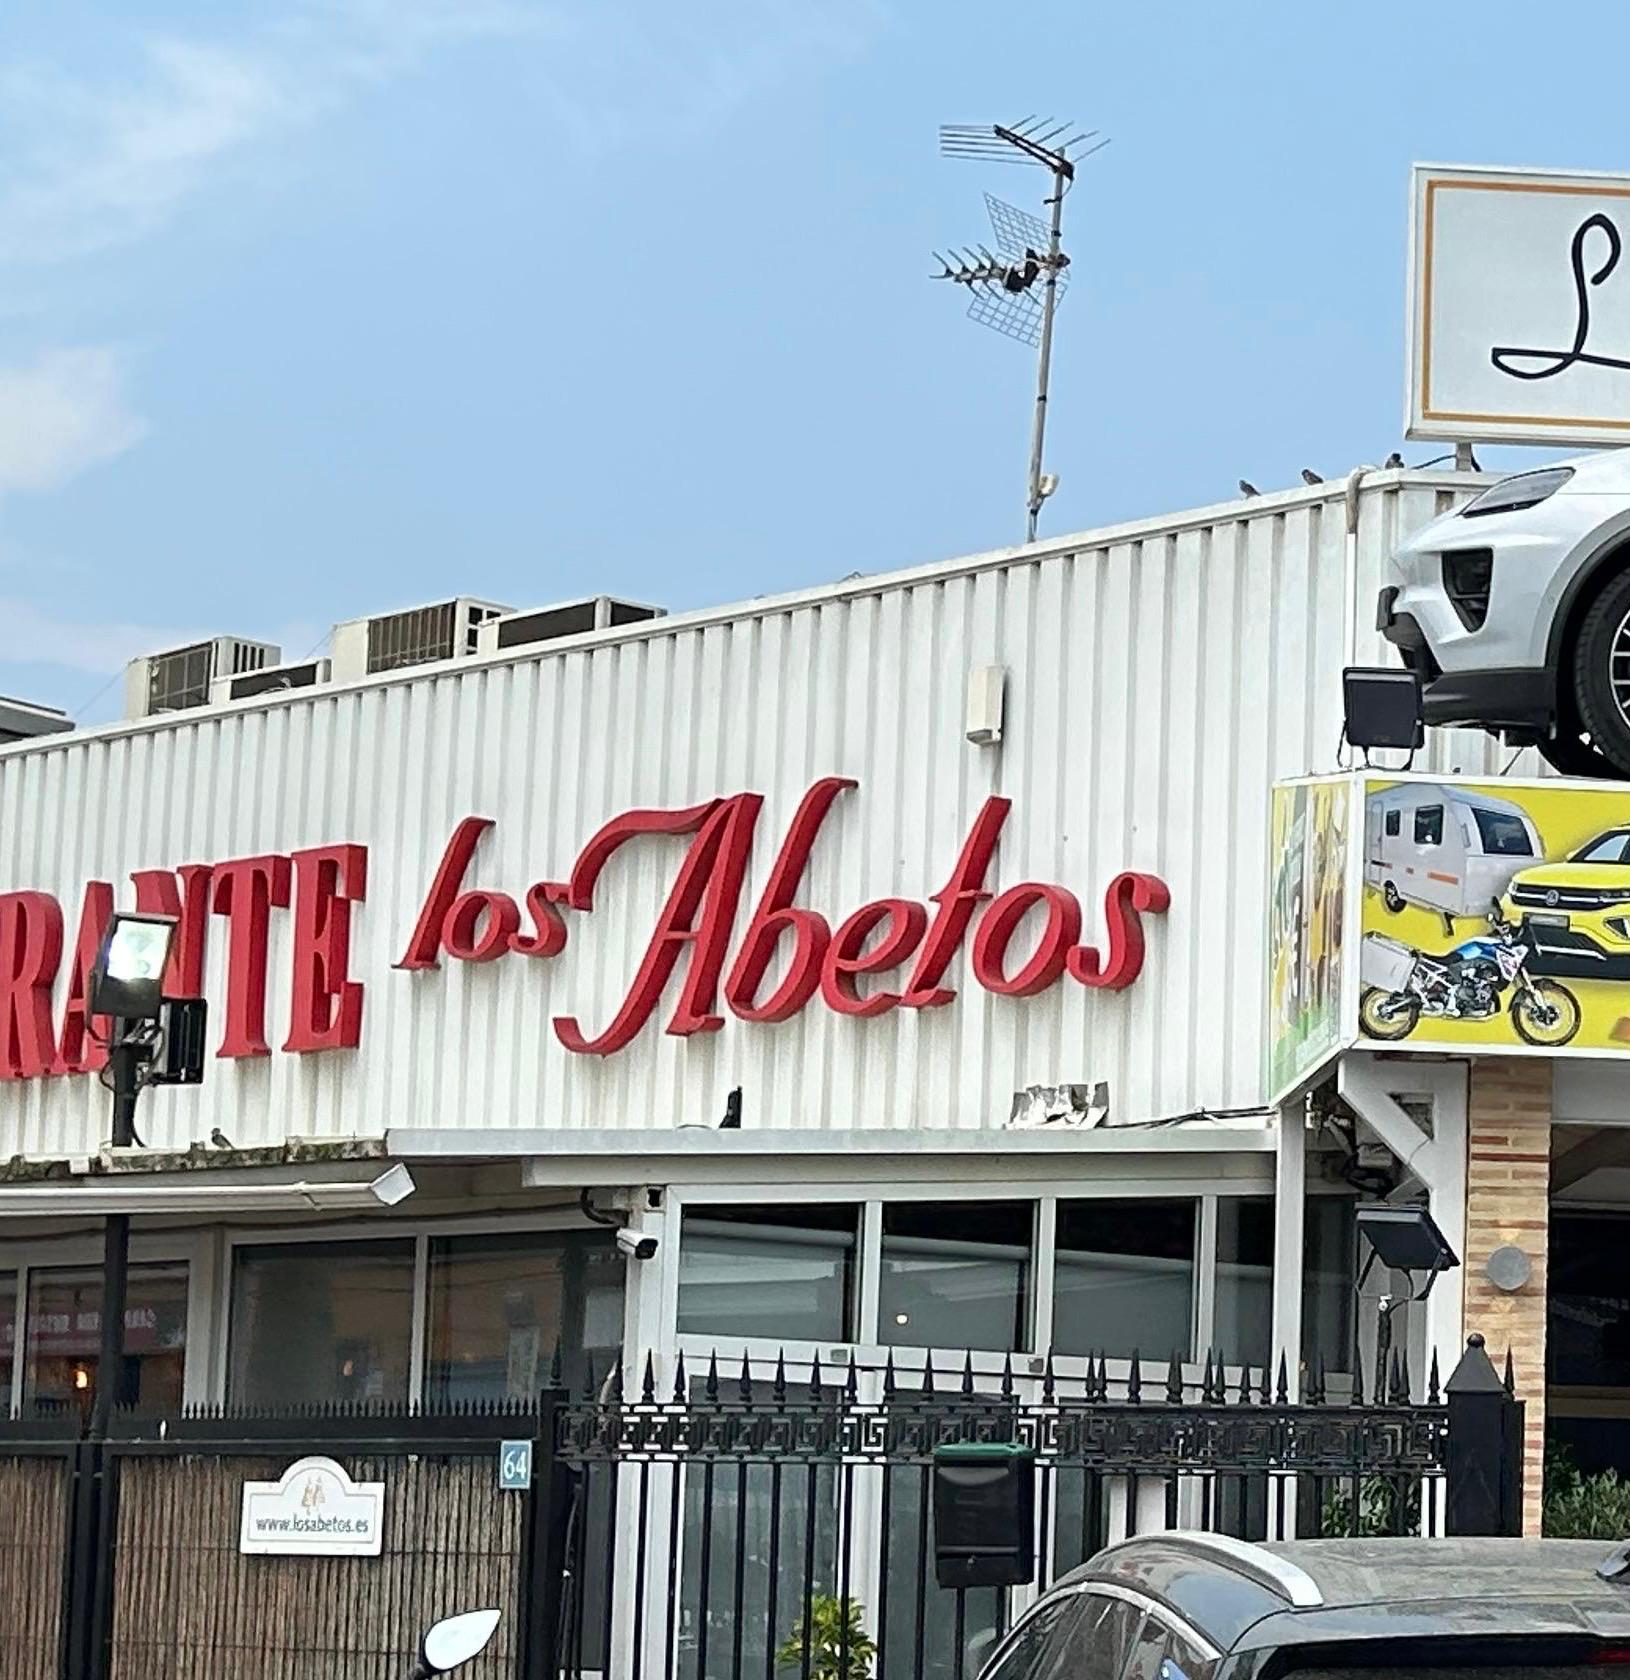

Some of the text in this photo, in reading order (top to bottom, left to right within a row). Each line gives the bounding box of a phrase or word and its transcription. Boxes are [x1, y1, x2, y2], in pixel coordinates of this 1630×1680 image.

[391, 815, 571, 970] los
[553, 776, 1171, 1057] Abetos
[503, 1449, 527, 1480] 64
[255, 1512, 369, 1534] www.losabetos.es
